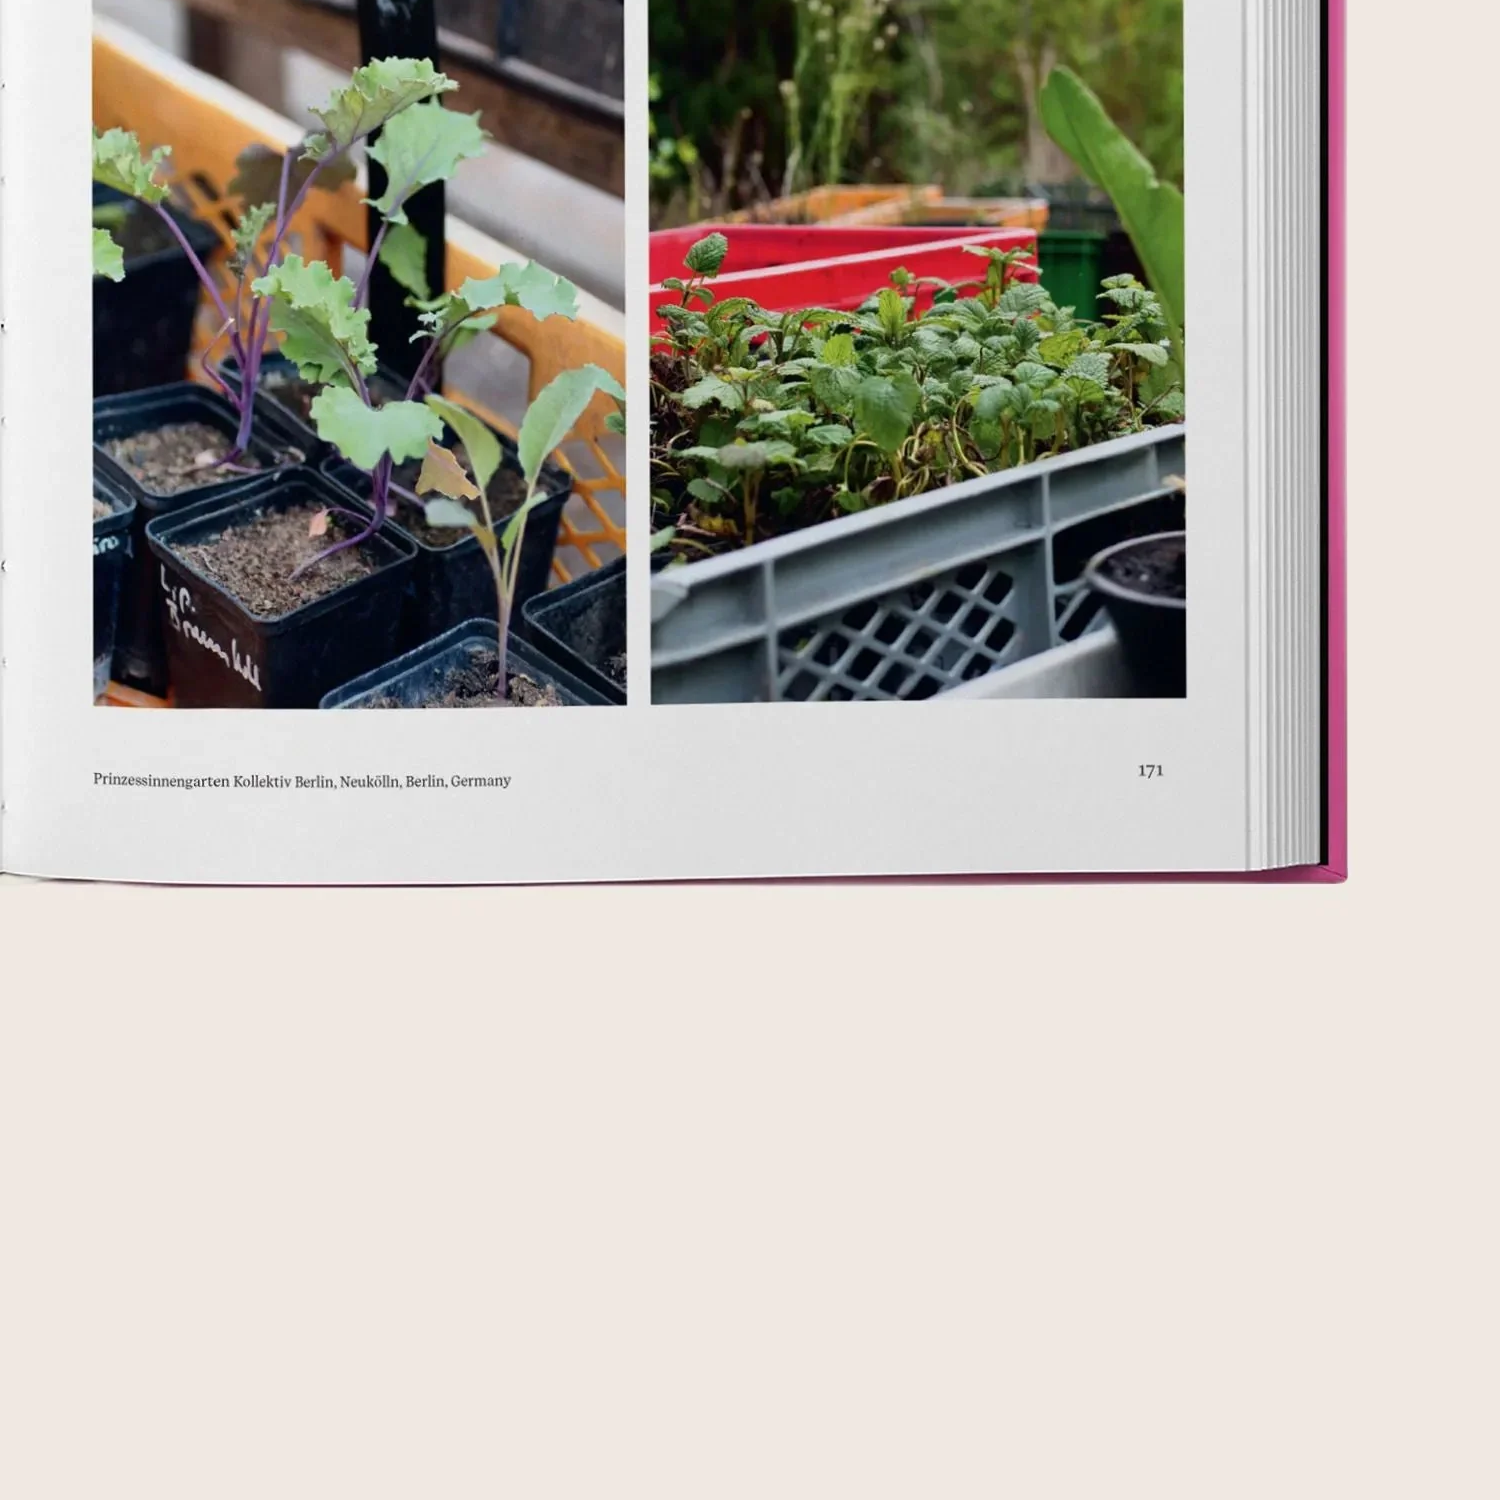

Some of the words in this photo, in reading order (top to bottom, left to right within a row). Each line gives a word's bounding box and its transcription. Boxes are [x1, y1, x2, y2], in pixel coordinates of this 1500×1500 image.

[1138, 764, 1164, 779] 171
[93, 772, 229, 790] Prinzessinnengarten
[233, 774, 292, 789] Kollektiv
[295, 774, 338, 790] Berlin,
[340, 774, 403, 790] Neukölln,
[406, 774, 449, 790] Berlin,
[450, 774, 511, 790] Germany
